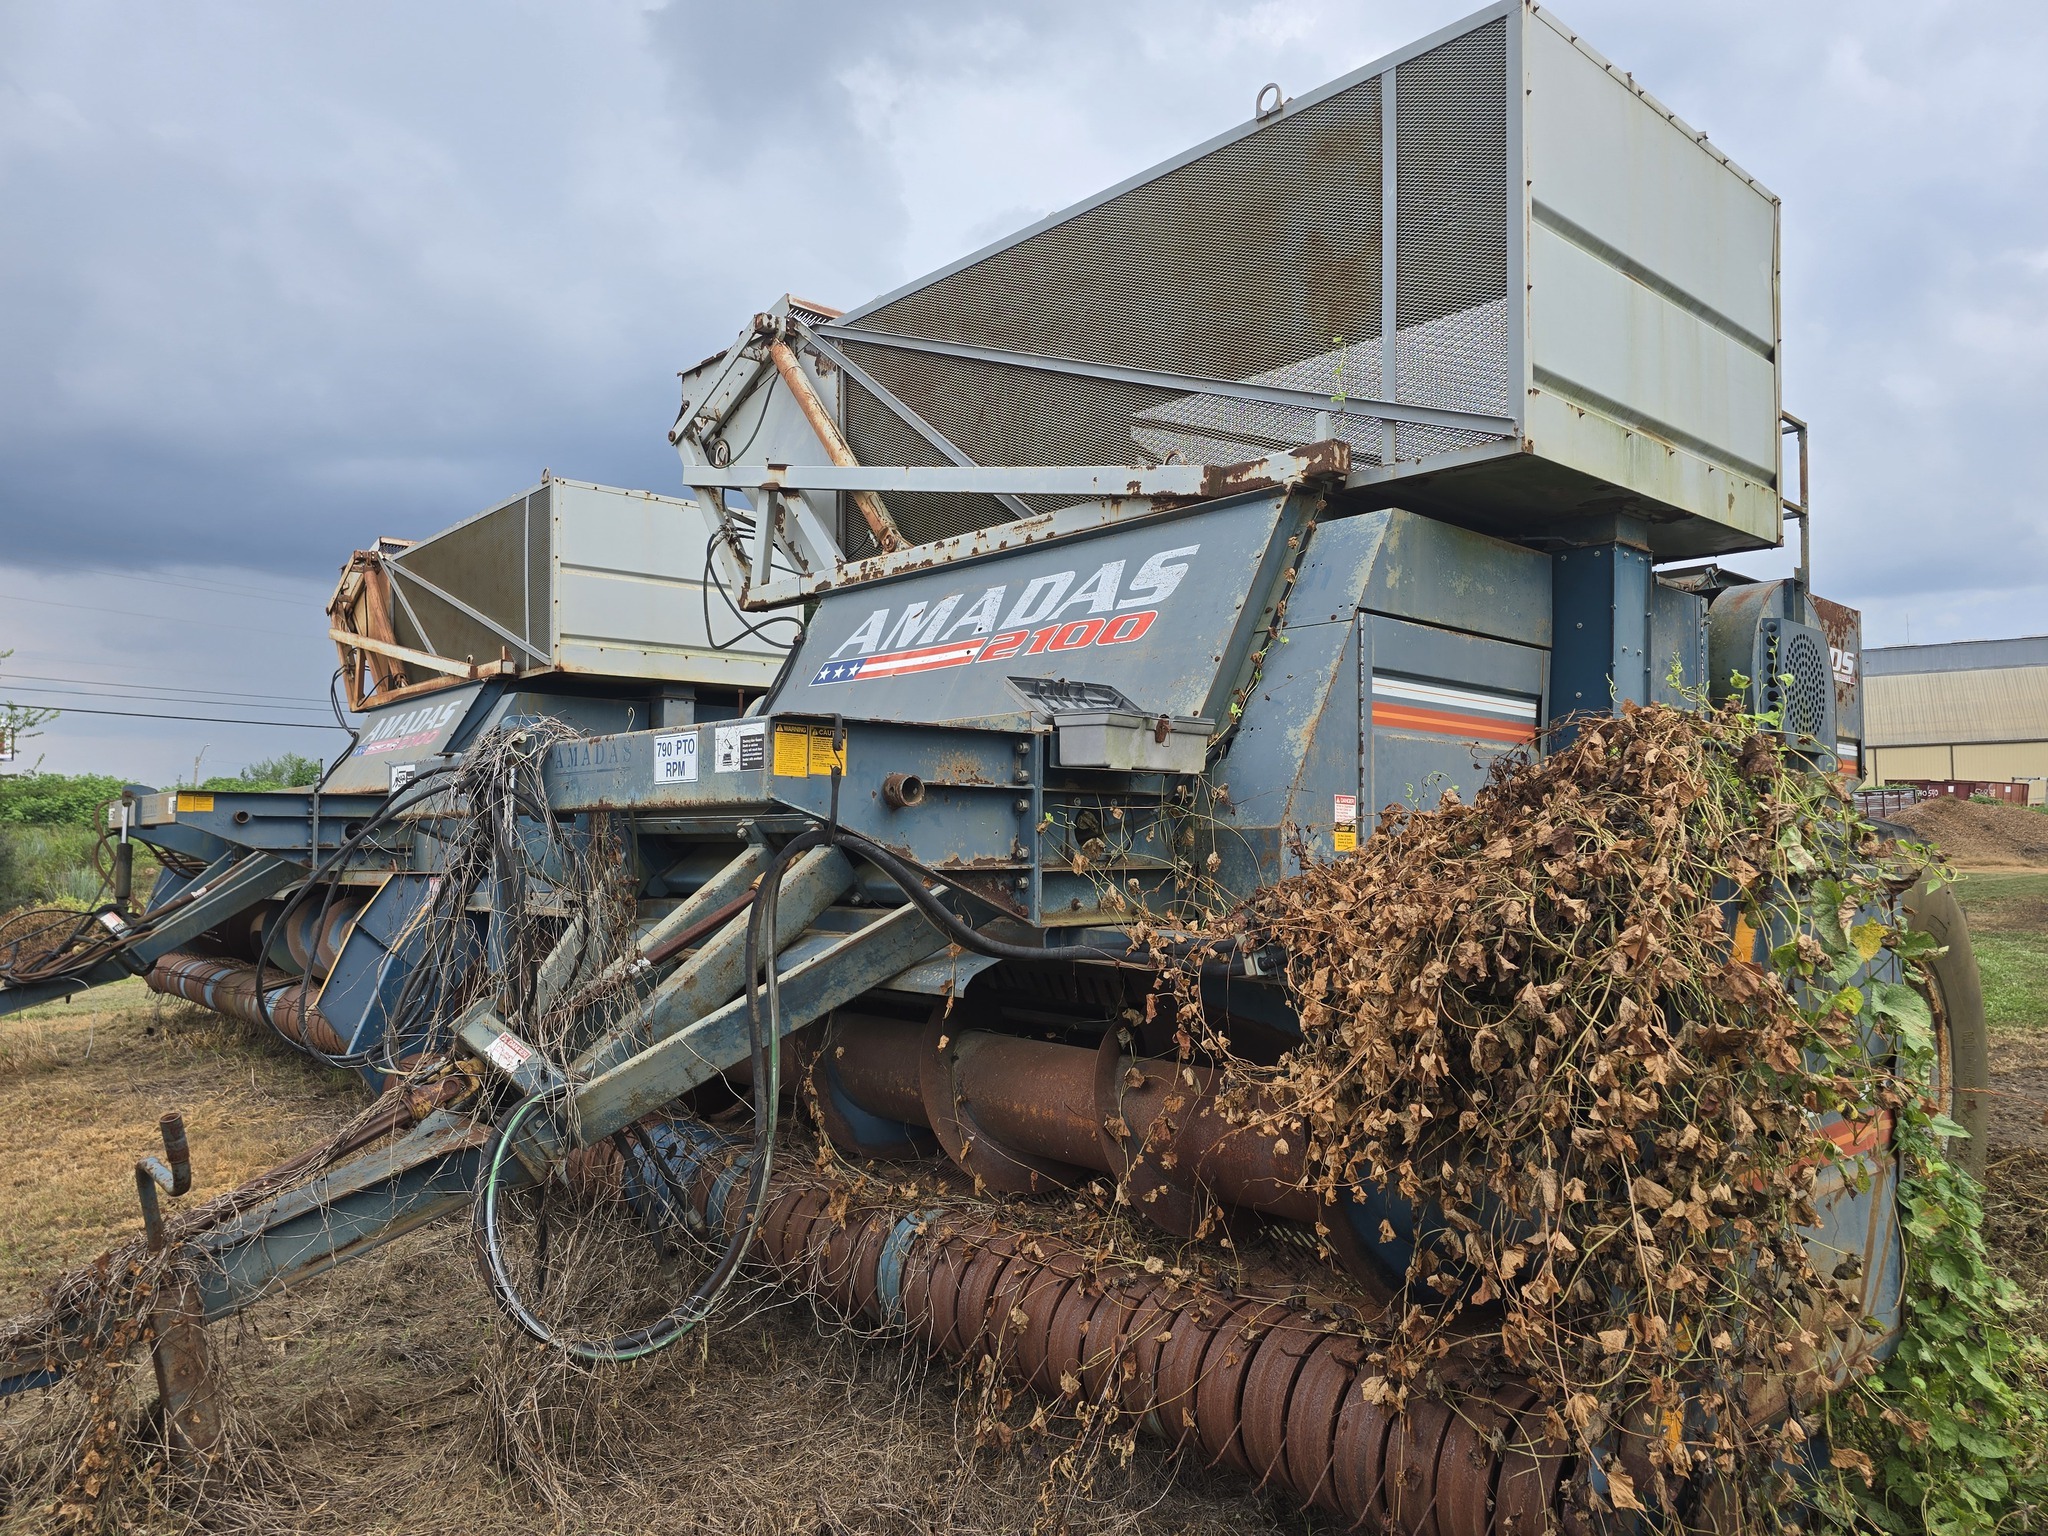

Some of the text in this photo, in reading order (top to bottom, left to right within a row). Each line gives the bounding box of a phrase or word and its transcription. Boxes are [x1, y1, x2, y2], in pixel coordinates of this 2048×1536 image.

[829, 543, 1201, 659] AMADAS
[976, 609, 1159, 663] 2100
[361, 699, 463, 744] AMADAS
[818, 729, 845, 738] CAUTN
[555, 740, 632, 769] AMADAS
[656, 737, 695, 758] 790 PTO
[665, 760, 686, 778] RPM
